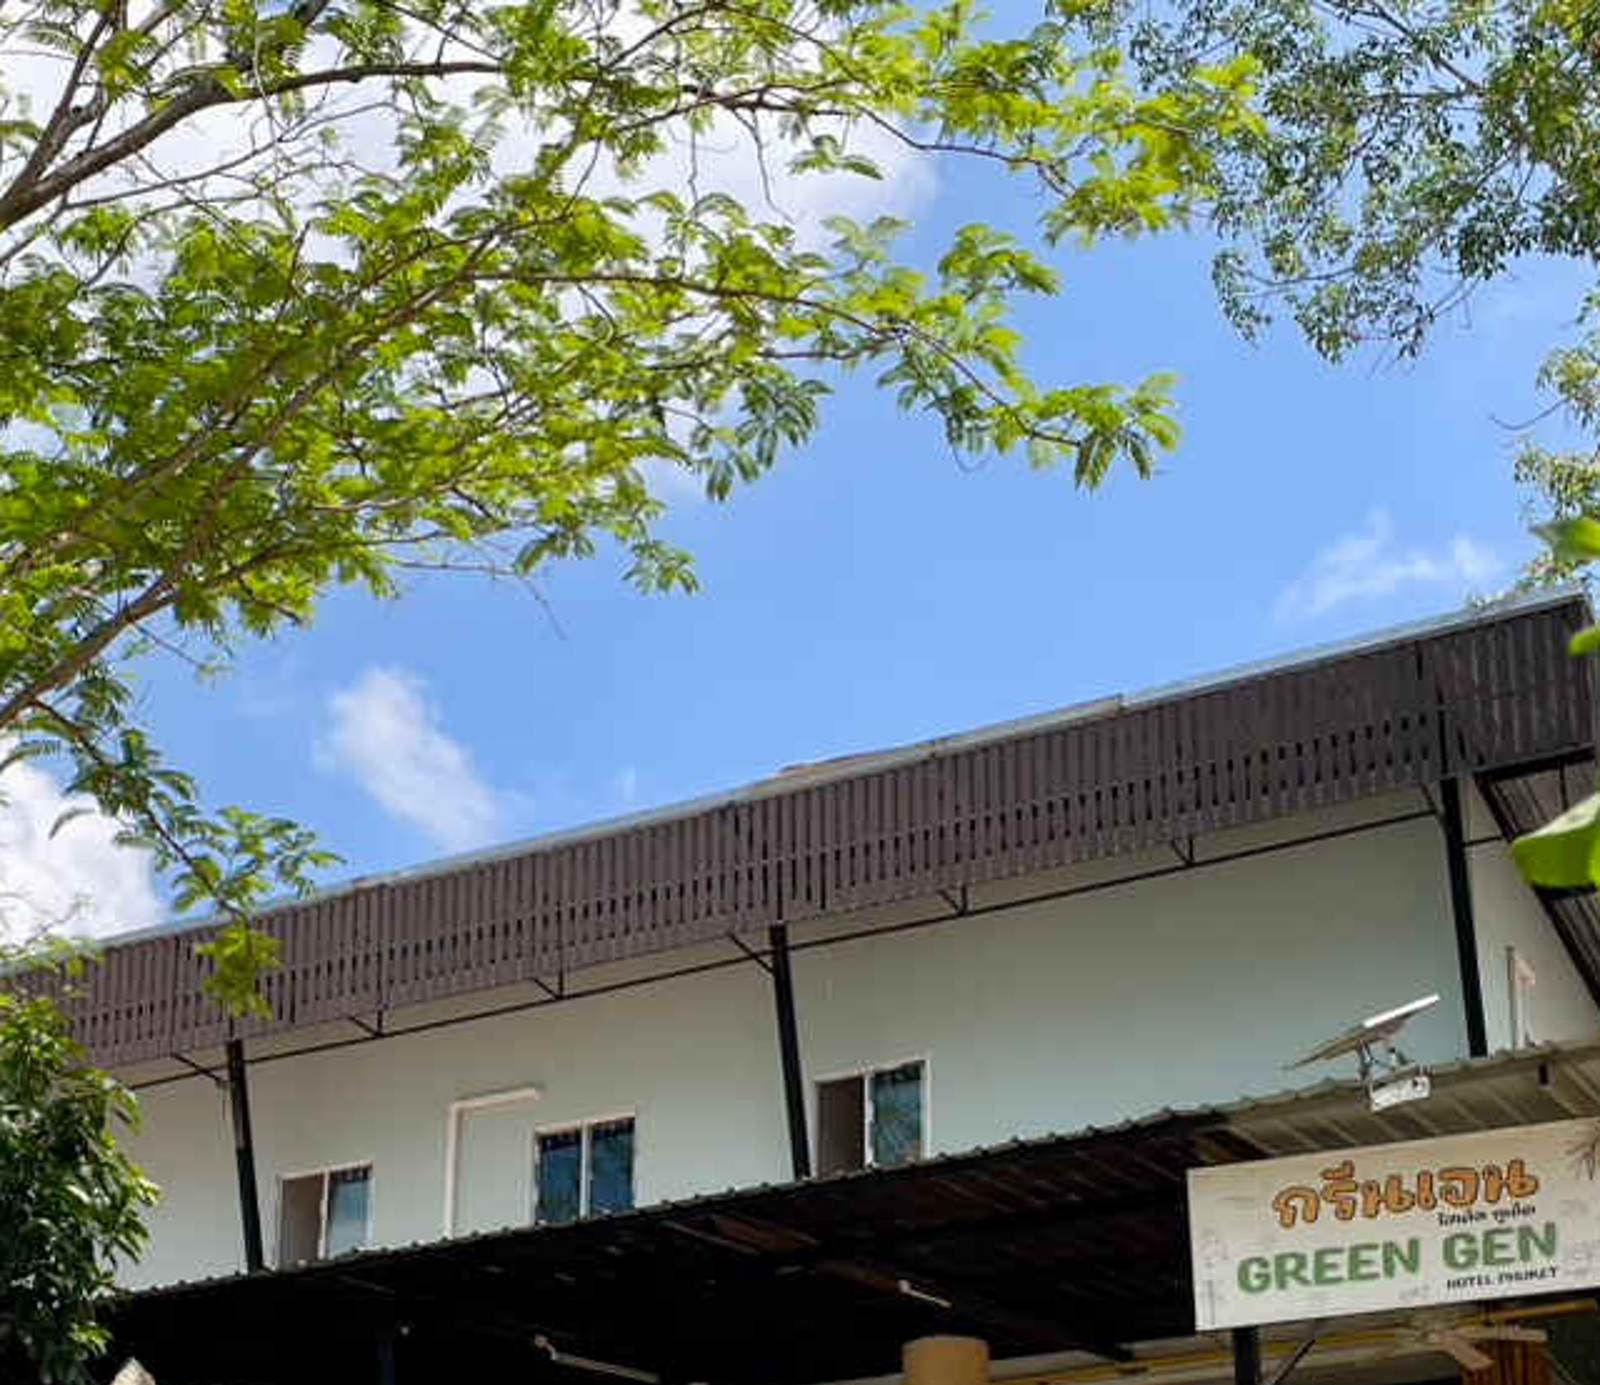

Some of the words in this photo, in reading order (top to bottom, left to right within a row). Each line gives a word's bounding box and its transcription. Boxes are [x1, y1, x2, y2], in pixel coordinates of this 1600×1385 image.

[1236, 1237, 1420, 1294] GREEN
[1441, 1221, 1557, 1271] GEN
[1446, 1274, 1494, 1290] HOTEL
